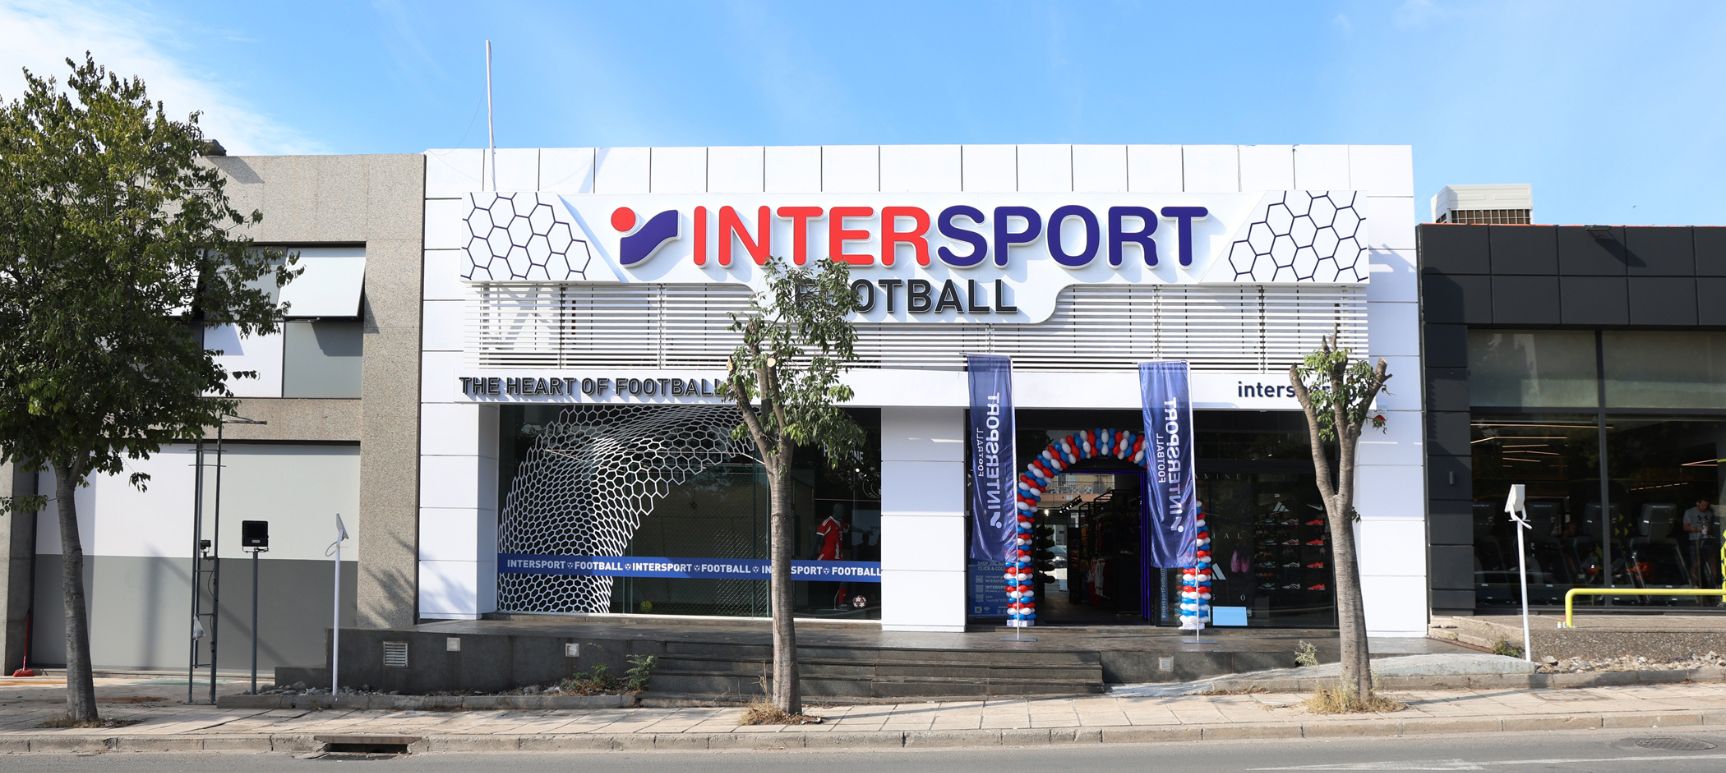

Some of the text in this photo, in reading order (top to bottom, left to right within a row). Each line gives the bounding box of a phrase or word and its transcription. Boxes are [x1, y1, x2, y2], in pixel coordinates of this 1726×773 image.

[693, 204, 1208, 268] INTERSPORT
[459, 377, 499, 396] THE
[506, 377, 575, 396] HEART
[581, 378, 609, 396] OF
[507, 559, 881, 577] INTERSPORT FOOTBALL INTERSPORT FOOTBALL INSPORT FOOTBALL
